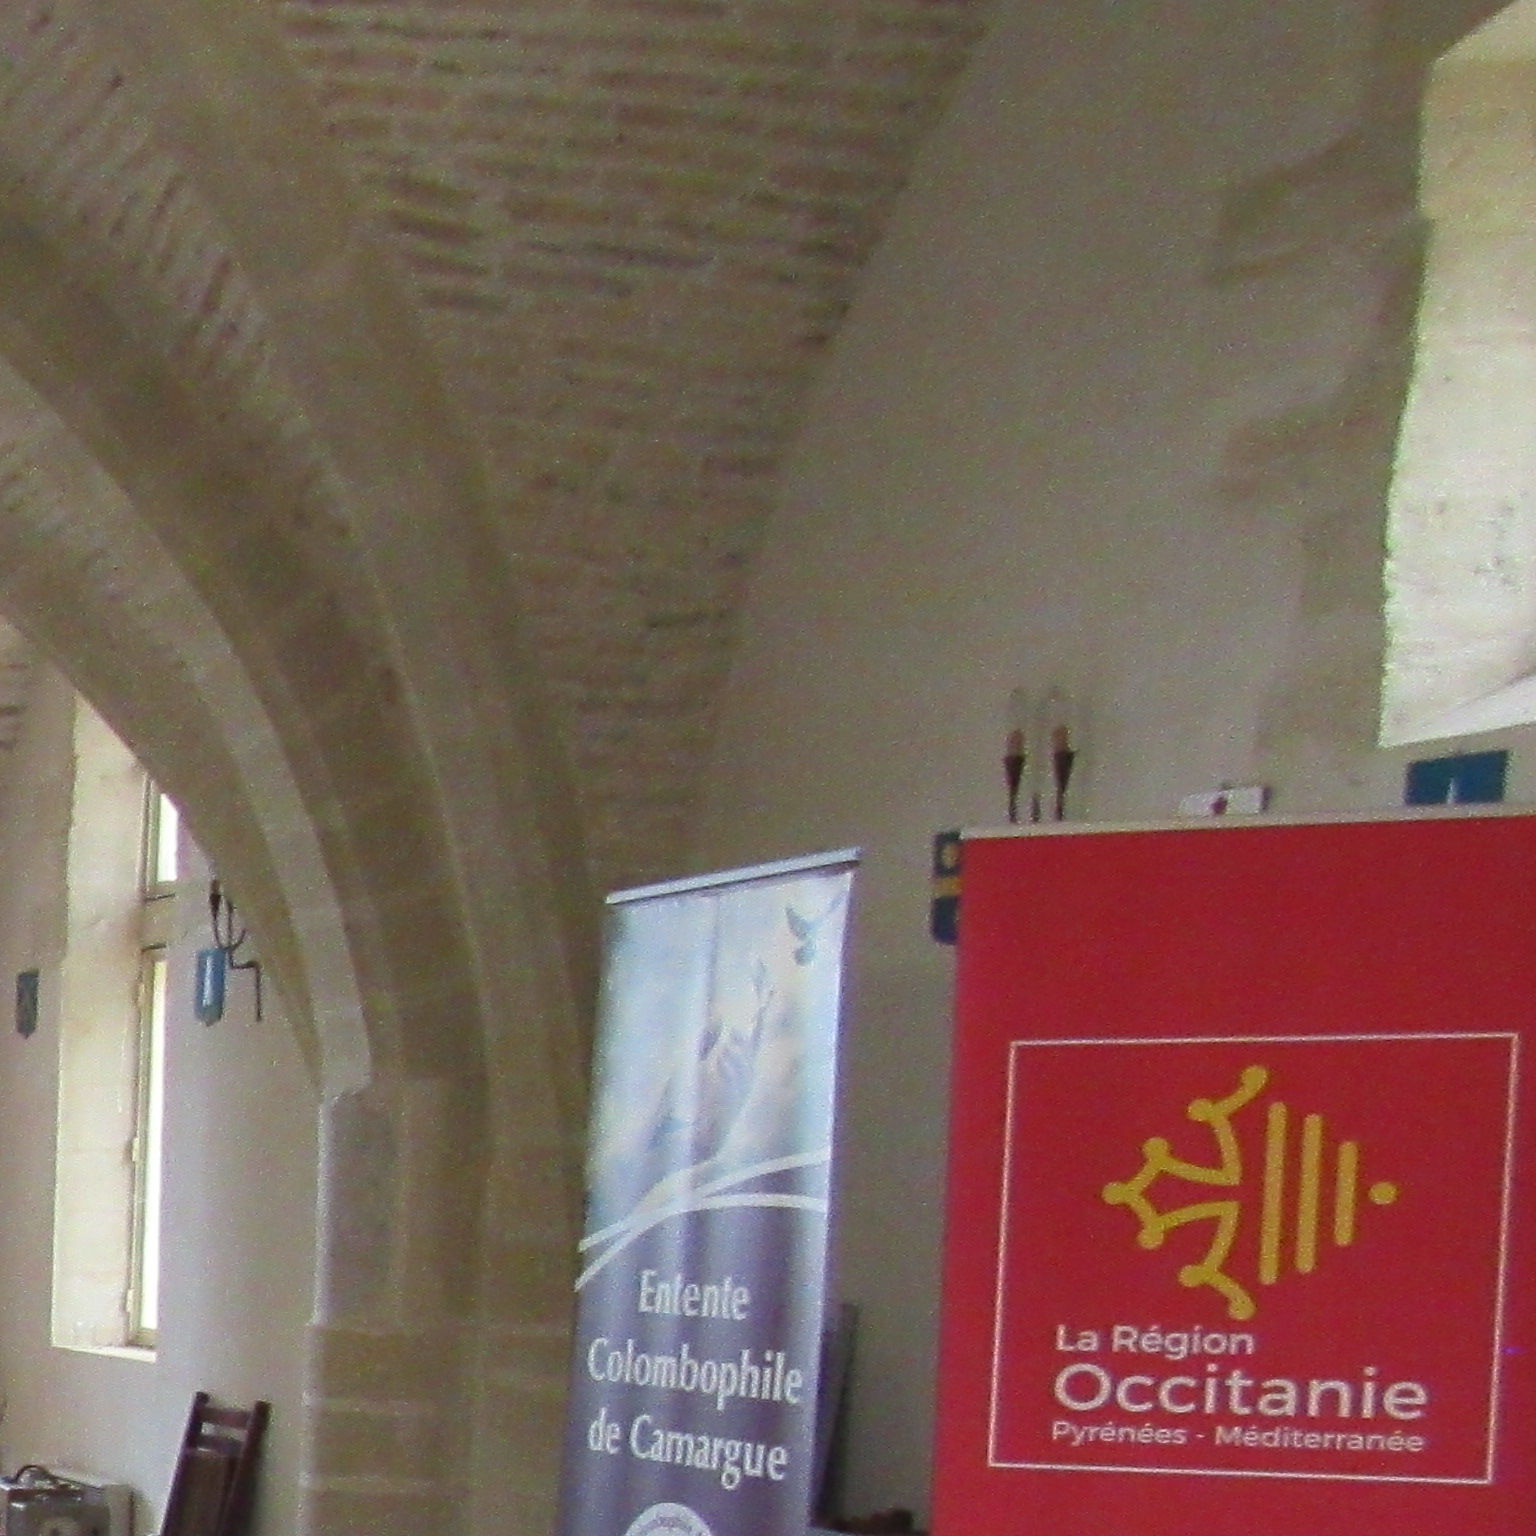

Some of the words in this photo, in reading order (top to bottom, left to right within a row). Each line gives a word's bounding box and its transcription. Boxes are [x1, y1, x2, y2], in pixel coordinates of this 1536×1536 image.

[638, 1269, 751, 1321] Entente
[1056, 1324, 1098, 1352] La
[1112, 1324, 1256, 1361] Région
[587, 1338, 803, 1412] Colombophile
[1054, 1363, 1427, 1420] Occitanie
[588, 1407, 621, 1454] de
[629, 1414, 789, 1491] Camargue
[1052, 1421, 1188, 1447] Pyrénées
[1214, 1425, 1425, 1453] Méditerranée
